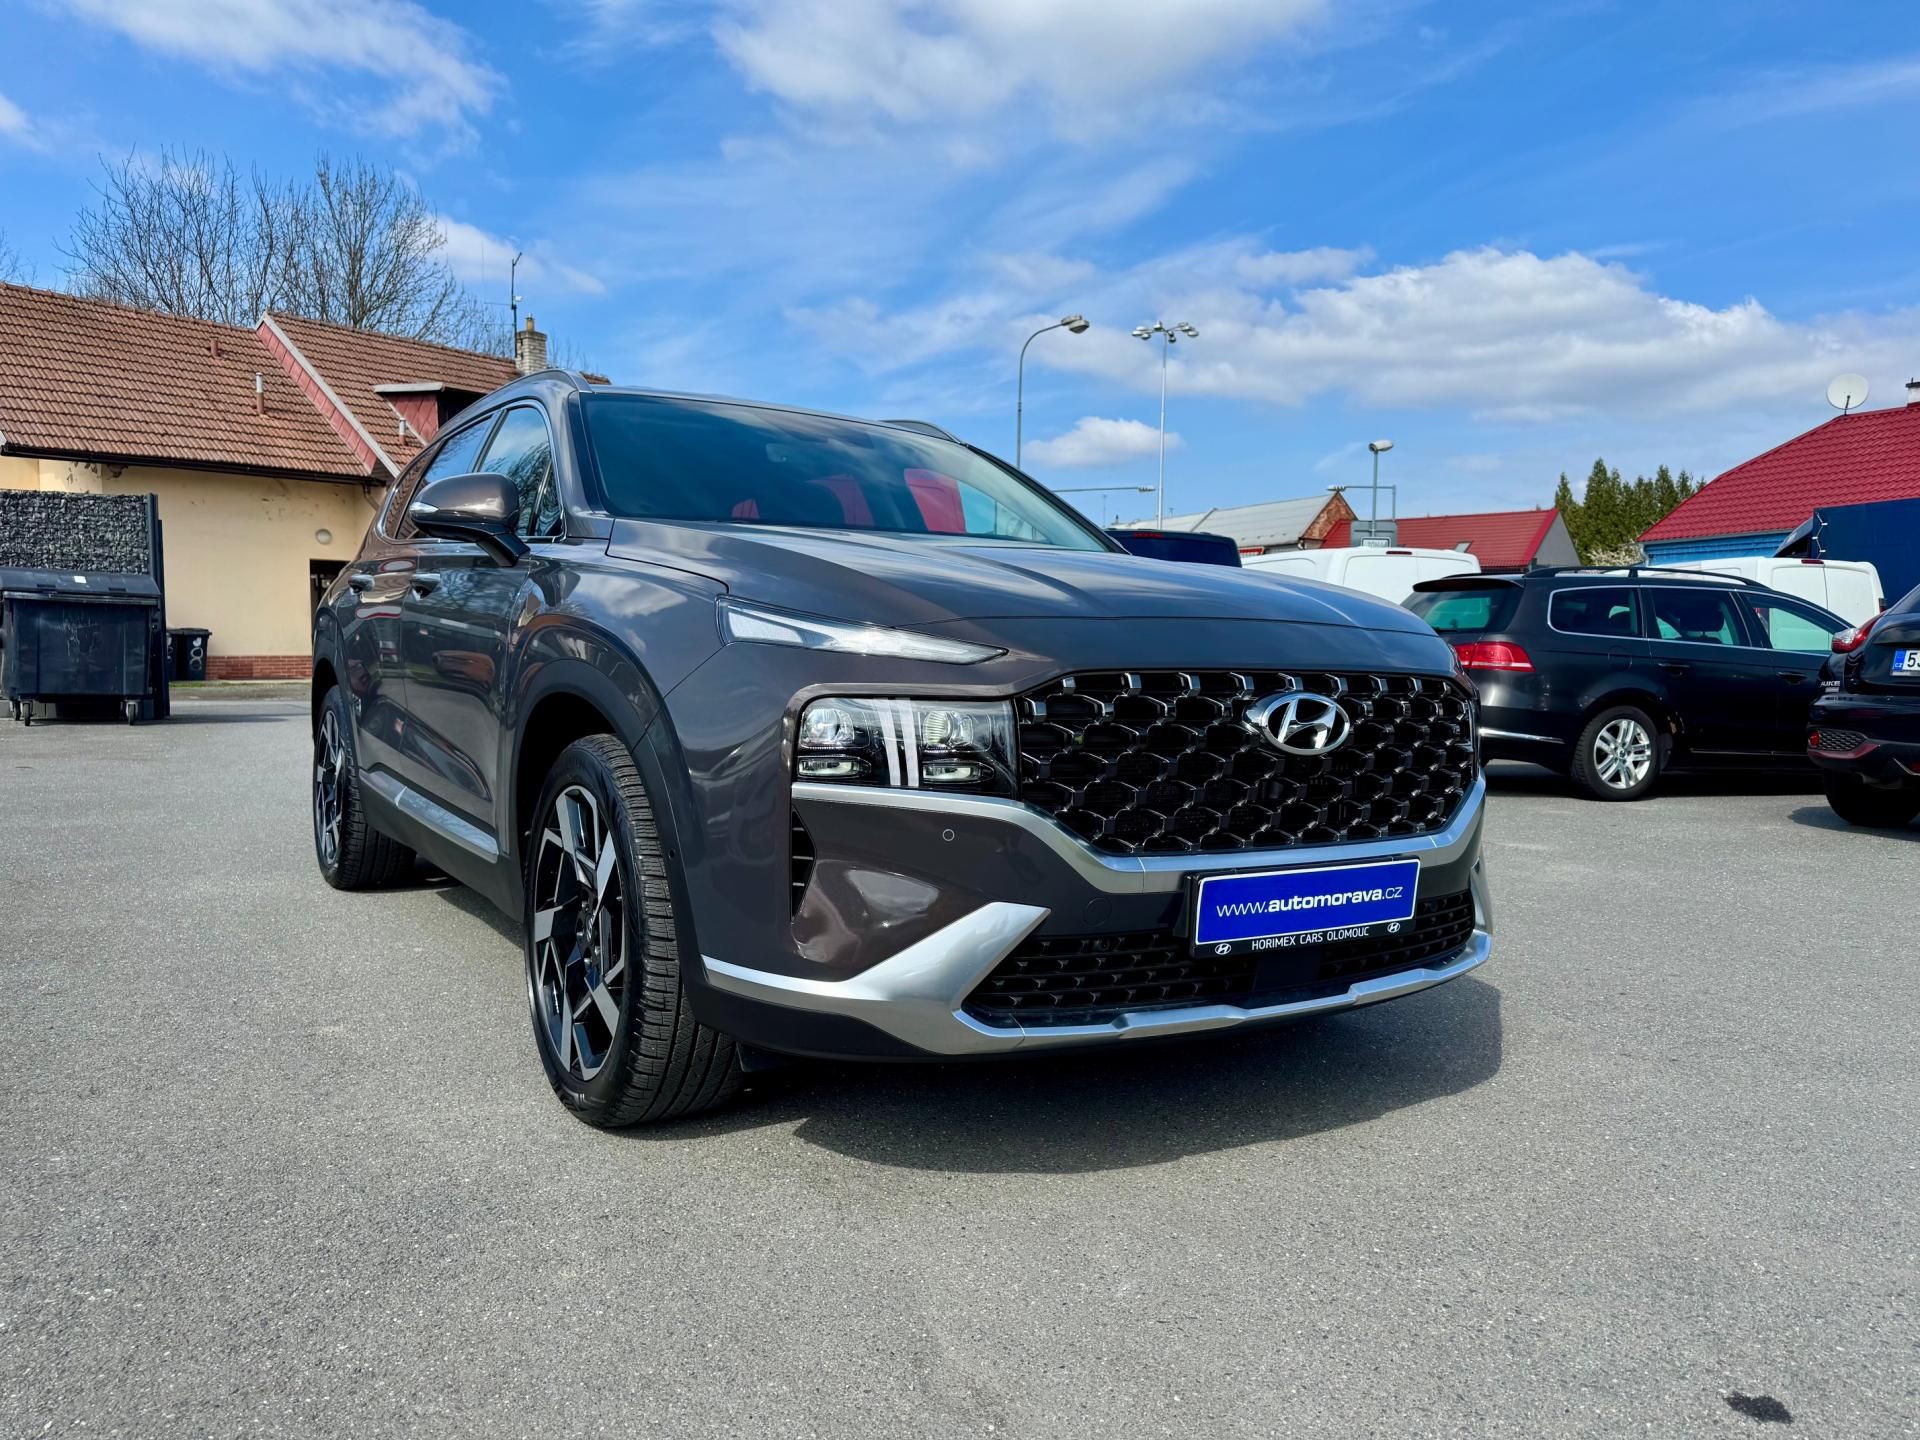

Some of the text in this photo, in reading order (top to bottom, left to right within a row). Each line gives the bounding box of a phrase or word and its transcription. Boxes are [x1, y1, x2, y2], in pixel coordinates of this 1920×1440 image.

[1216, 886, 1403, 918] www.automorava.cz
[1251, 926, 1370, 951] HORIMEX CARS OLOMOUC
